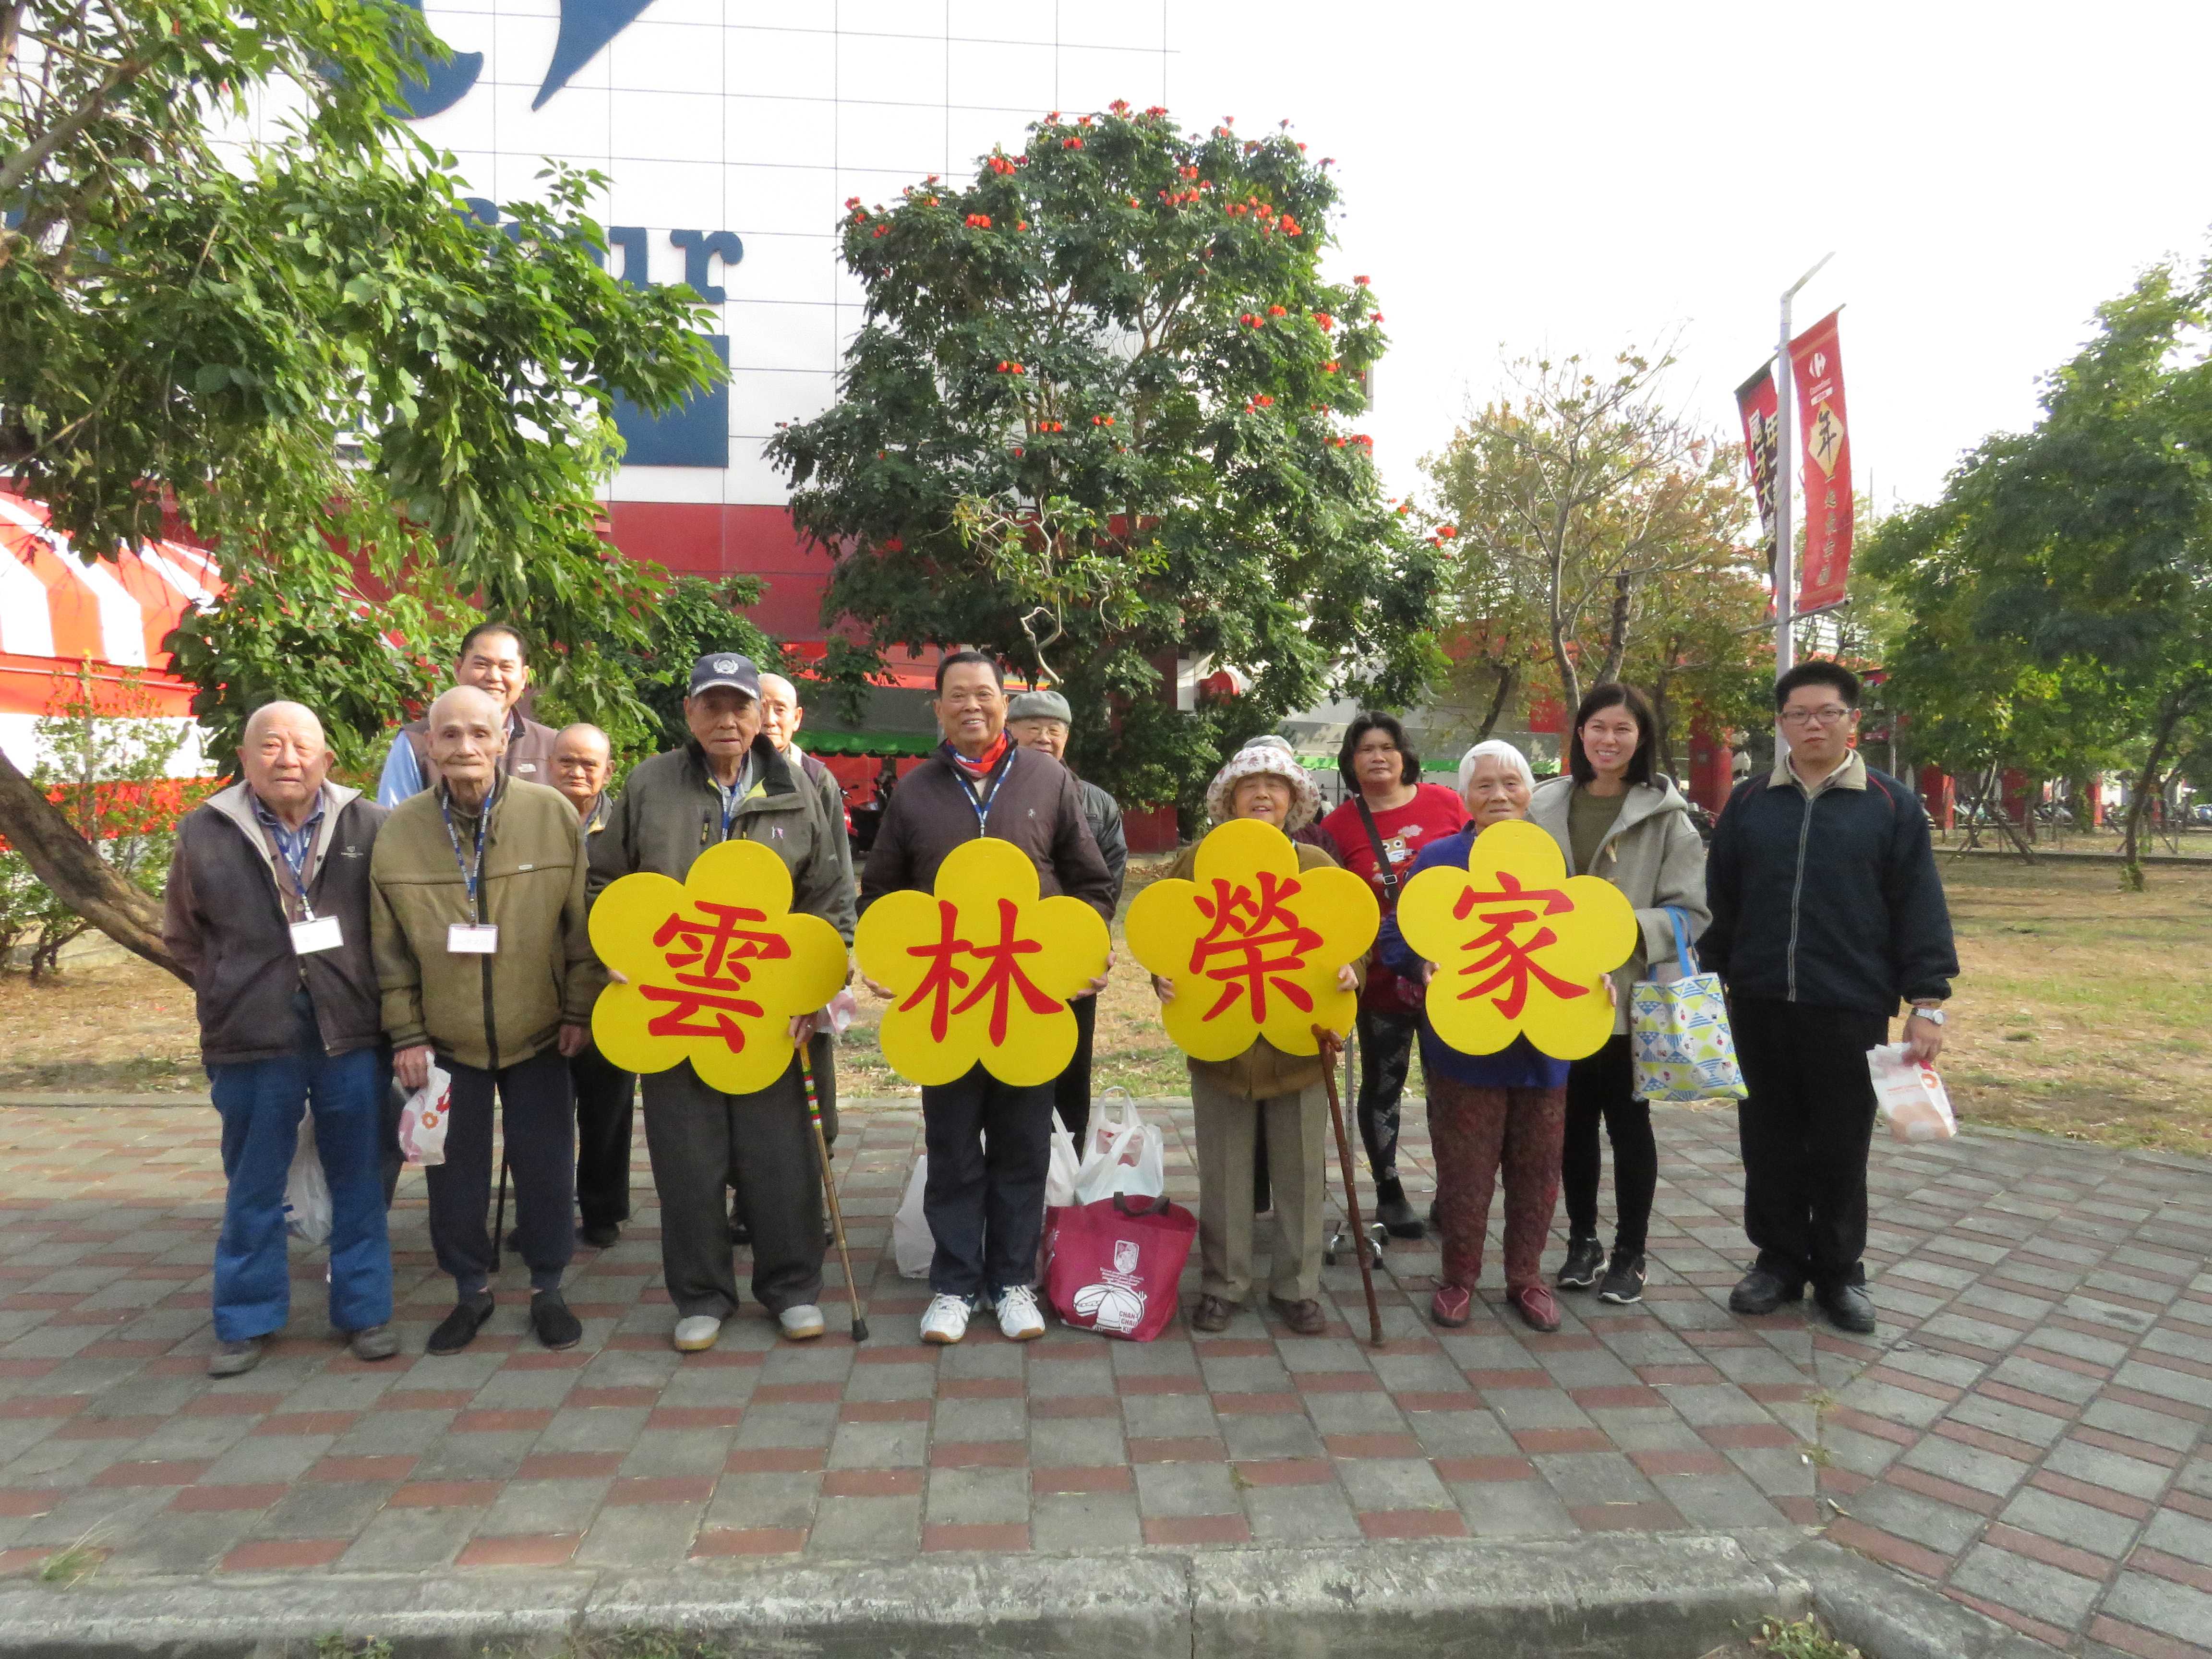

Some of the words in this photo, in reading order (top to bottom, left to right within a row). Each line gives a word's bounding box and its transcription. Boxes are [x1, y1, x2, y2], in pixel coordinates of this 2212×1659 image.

[1816, 410, 1837, 462] 年
[640, 902, 790, 1053] 雲
[901, 899, 1062, 1046] 林
[1190, 873, 1323, 1023] 榮
[1455, 872, 1588, 1019] 家
[1121, 1318, 1138, 1326] CHAU
